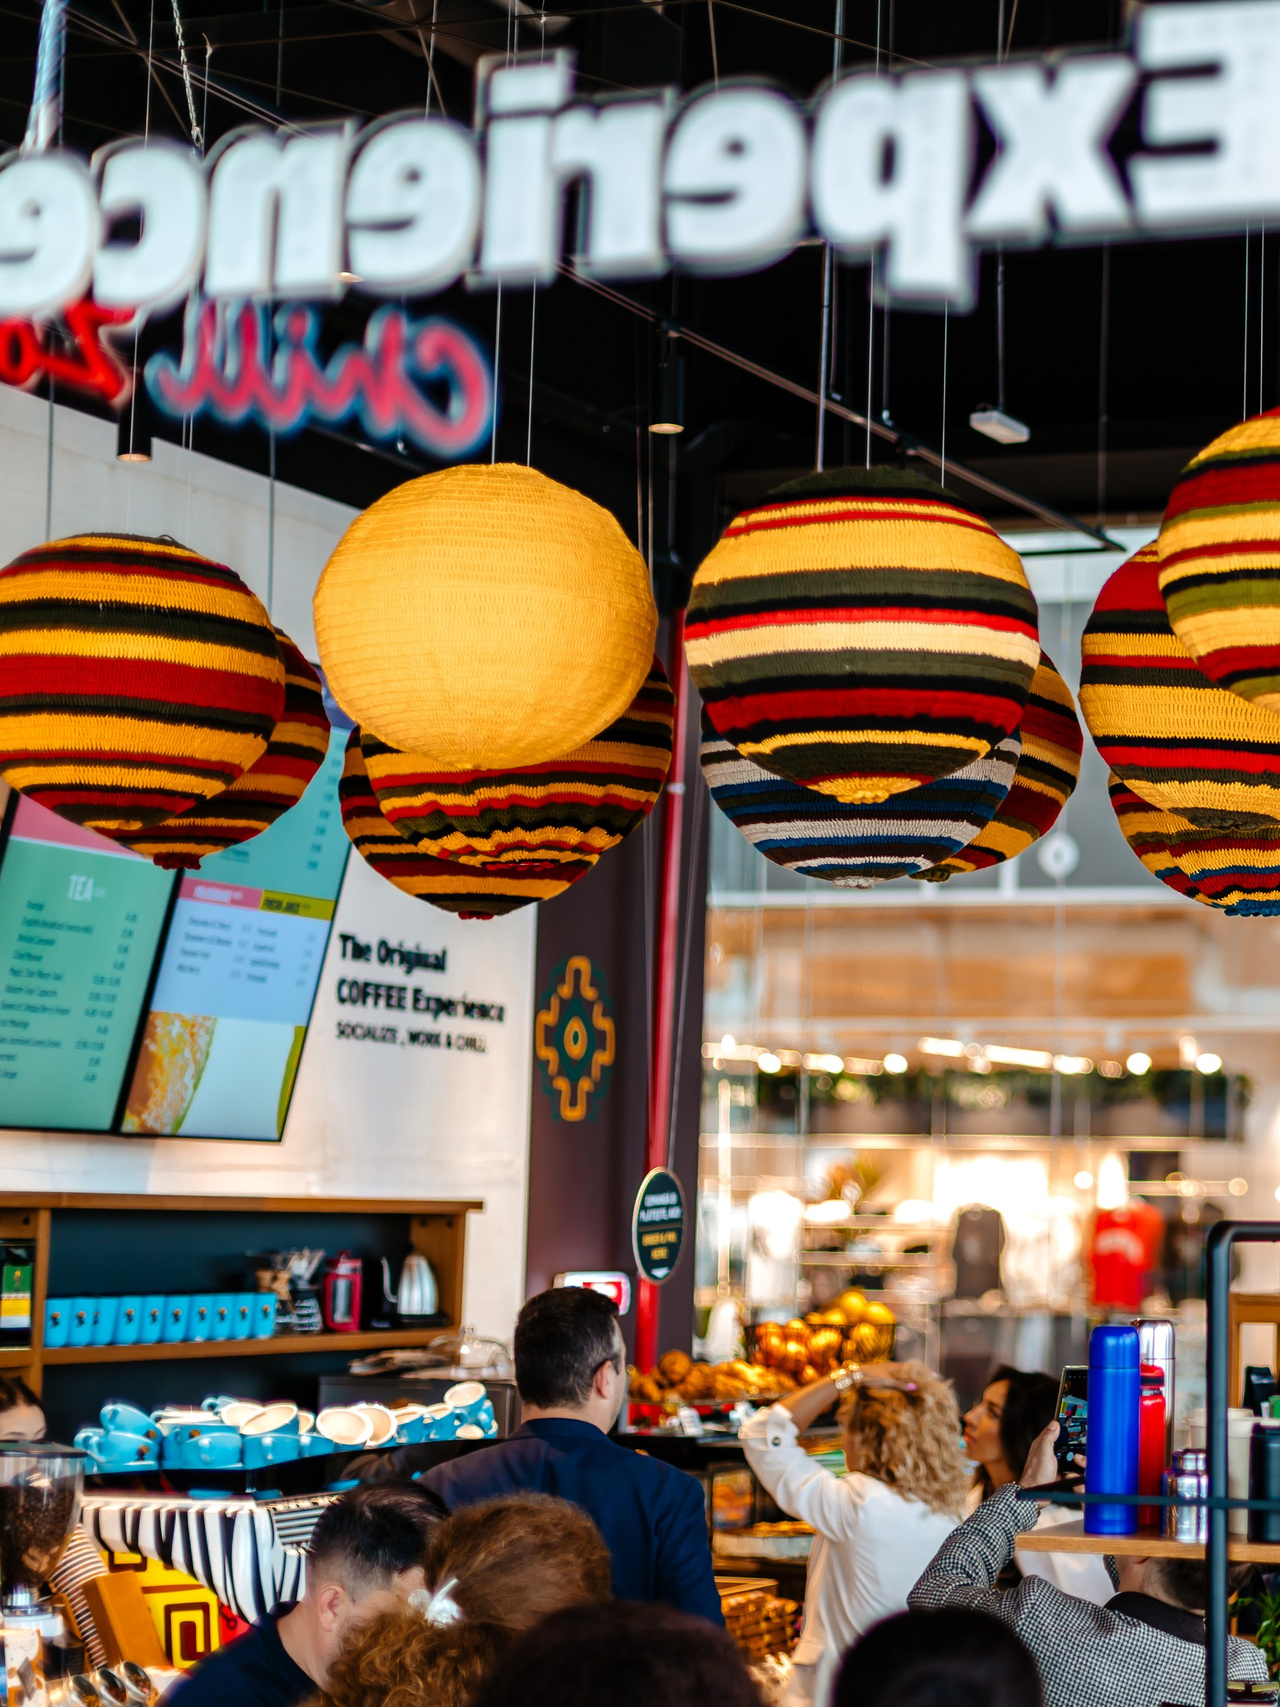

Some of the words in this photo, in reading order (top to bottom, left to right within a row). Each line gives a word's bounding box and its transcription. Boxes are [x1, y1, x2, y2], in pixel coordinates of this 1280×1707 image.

[66, 875, 94, 902] TEA
[338, 933, 372, 962] The
[377, 940, 447, 975] Original
[337, 978, 408, 1010] COFFEE
[412, 988, 505, 1021] Experience
[407, 1028, 442, 1048] WORK
